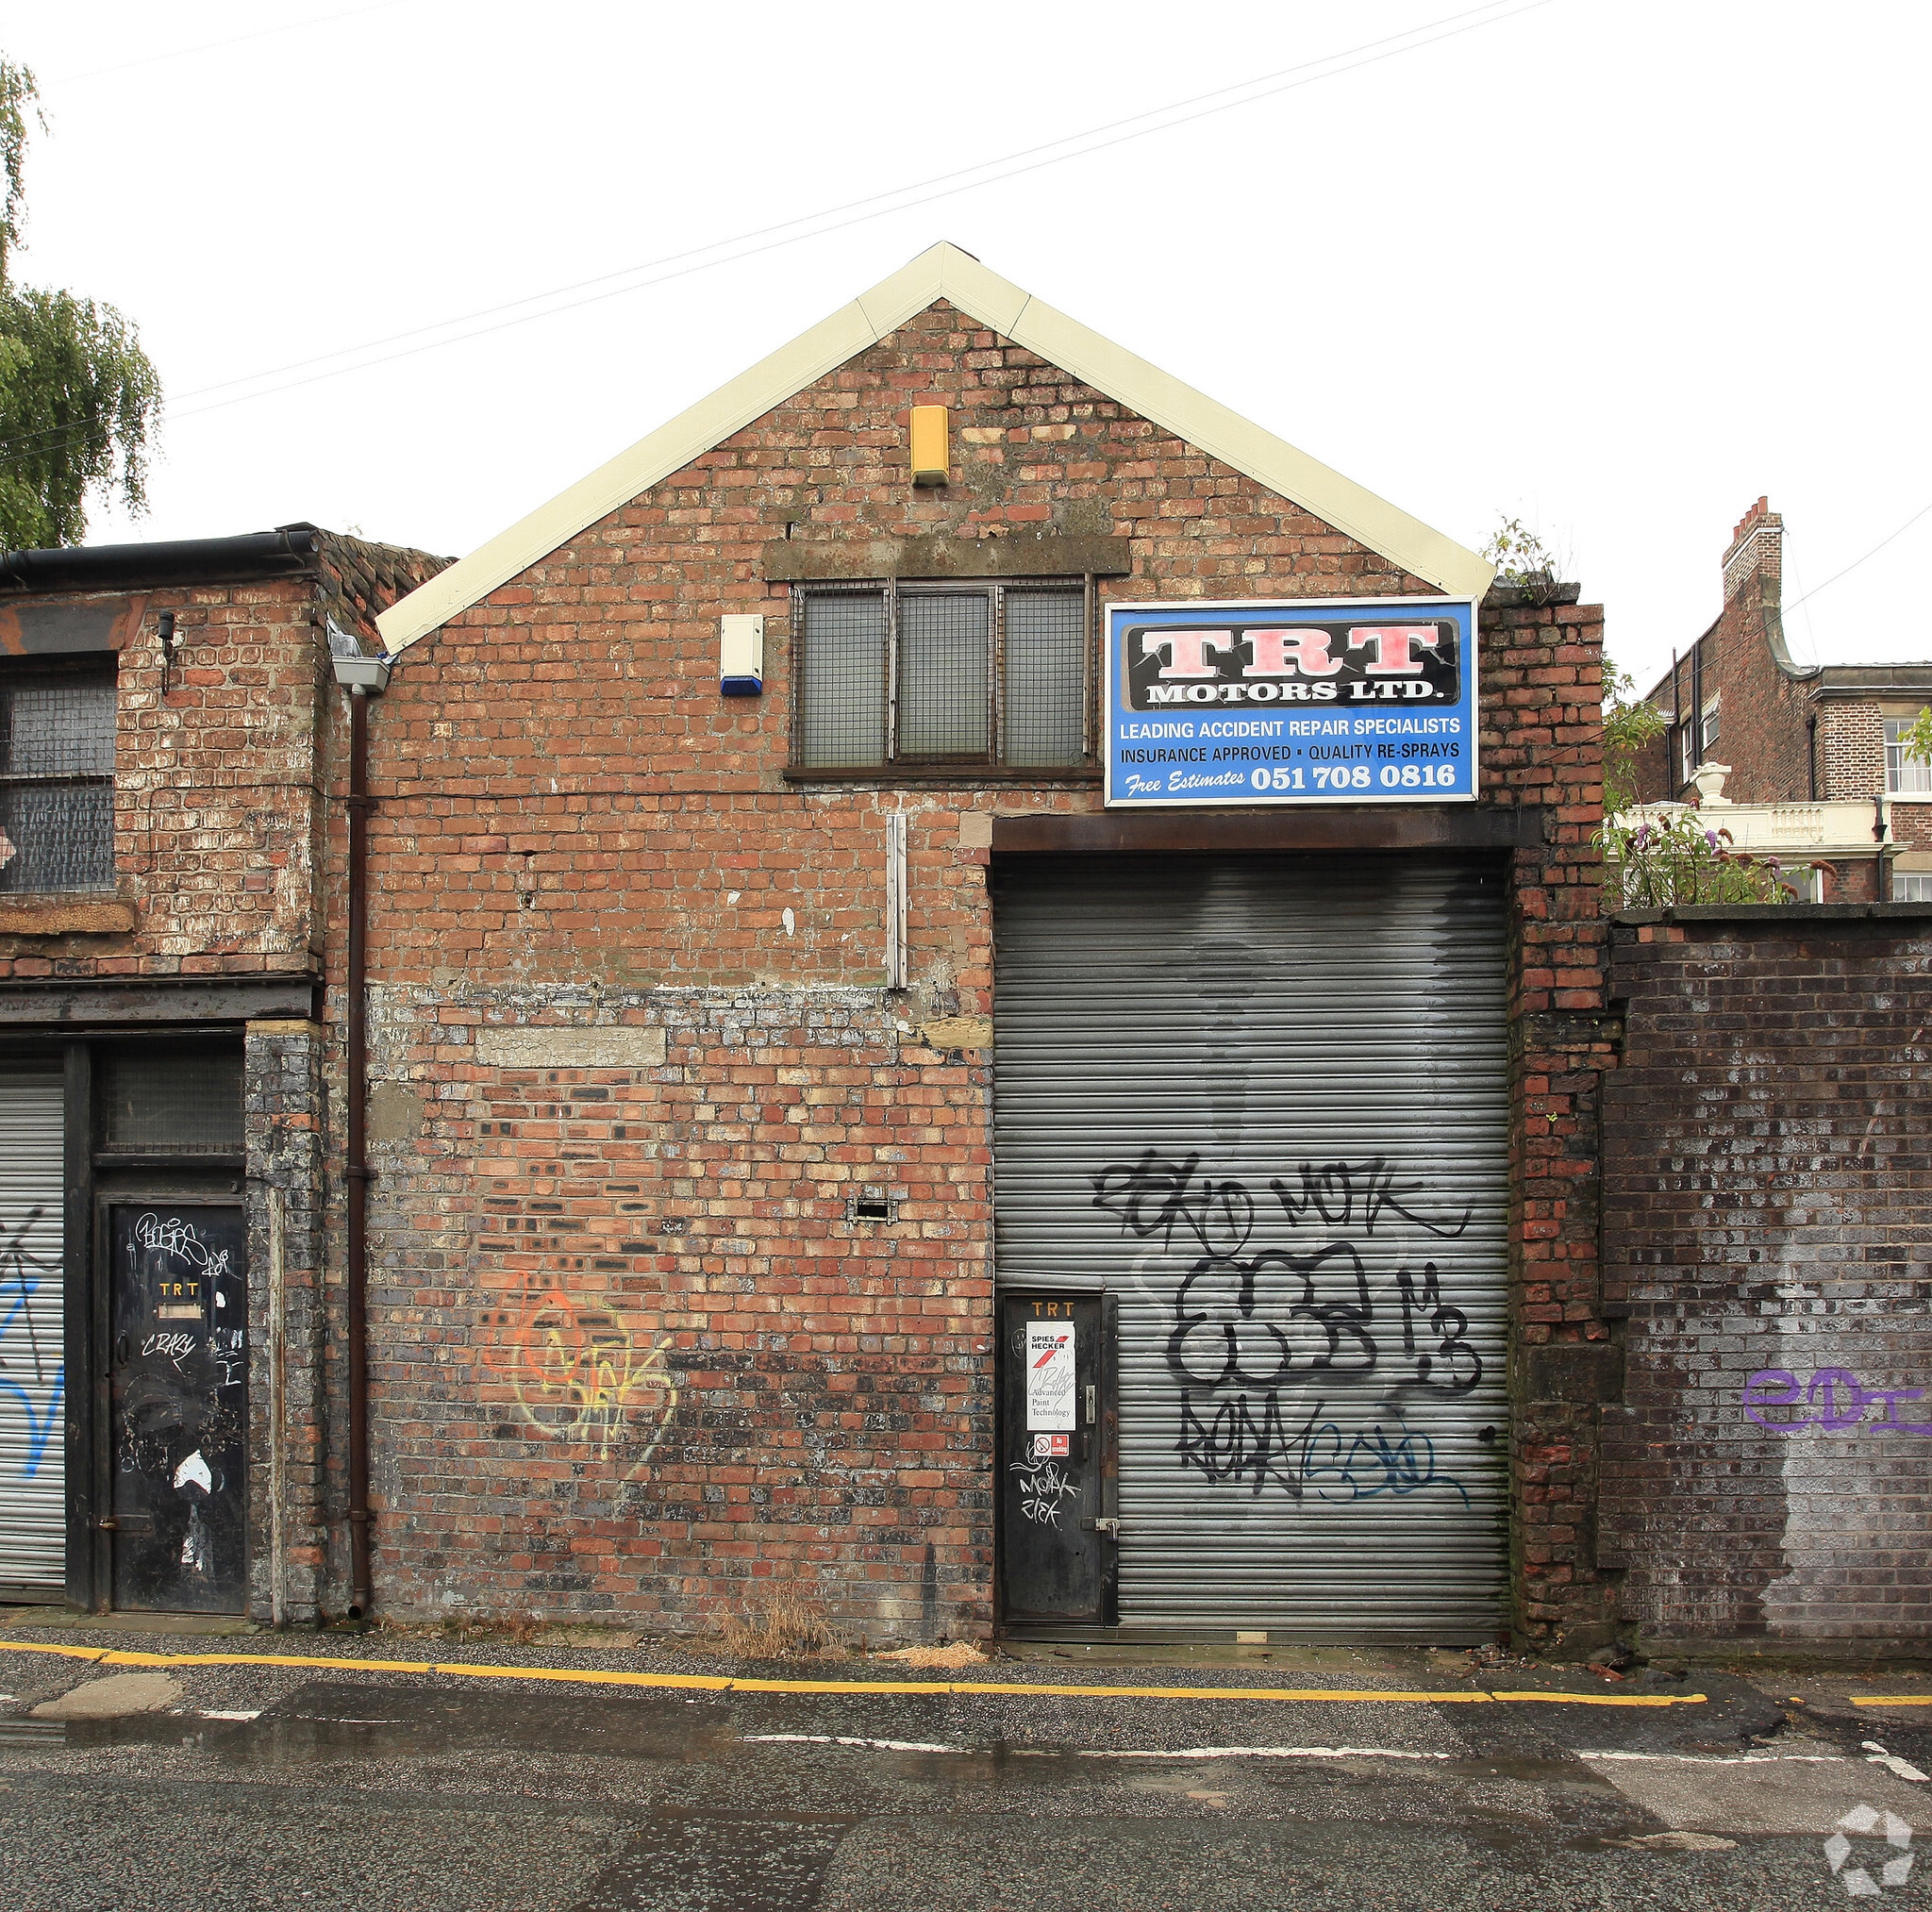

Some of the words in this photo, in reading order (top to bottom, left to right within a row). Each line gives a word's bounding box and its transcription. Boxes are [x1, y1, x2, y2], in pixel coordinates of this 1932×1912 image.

[1142, 625, 1439, 678] TRT
[1146, 681, 1337, 704] MOTORS
[1350, 680, 1444, 700] LTD.
[1120, 723, 1194, 740] LEADING
[1199, 721, 1285, 738] ACCIDENT
[1290, 720, 1349, 737] REPAIR
[1354, 718, 1461, 735] SPECIALISTS
[1121, 747, 1207, 763] INSURANCE
[1212, 745, 1291, 762] APPROVED
[1309, 744, 1373, 760] QUALITY
[1377, 742, 1459, 758] RE-SPRAYS
[1124, 773, 1162, 797] Free
[1167, 770, 1245, 791] Estimates
[1250, 767, 1306, 790] 051
[1312, 765, 1372, 789] 708
[1379, 764, 1456, 788] 0816
[158, 1283, 199, 1296] TRT
[1032, 1302, 1074, 1317] TRT
[1031, 1398, 1050, 1406] Paint
[1031, 1408, 1071, 1417] Technology
